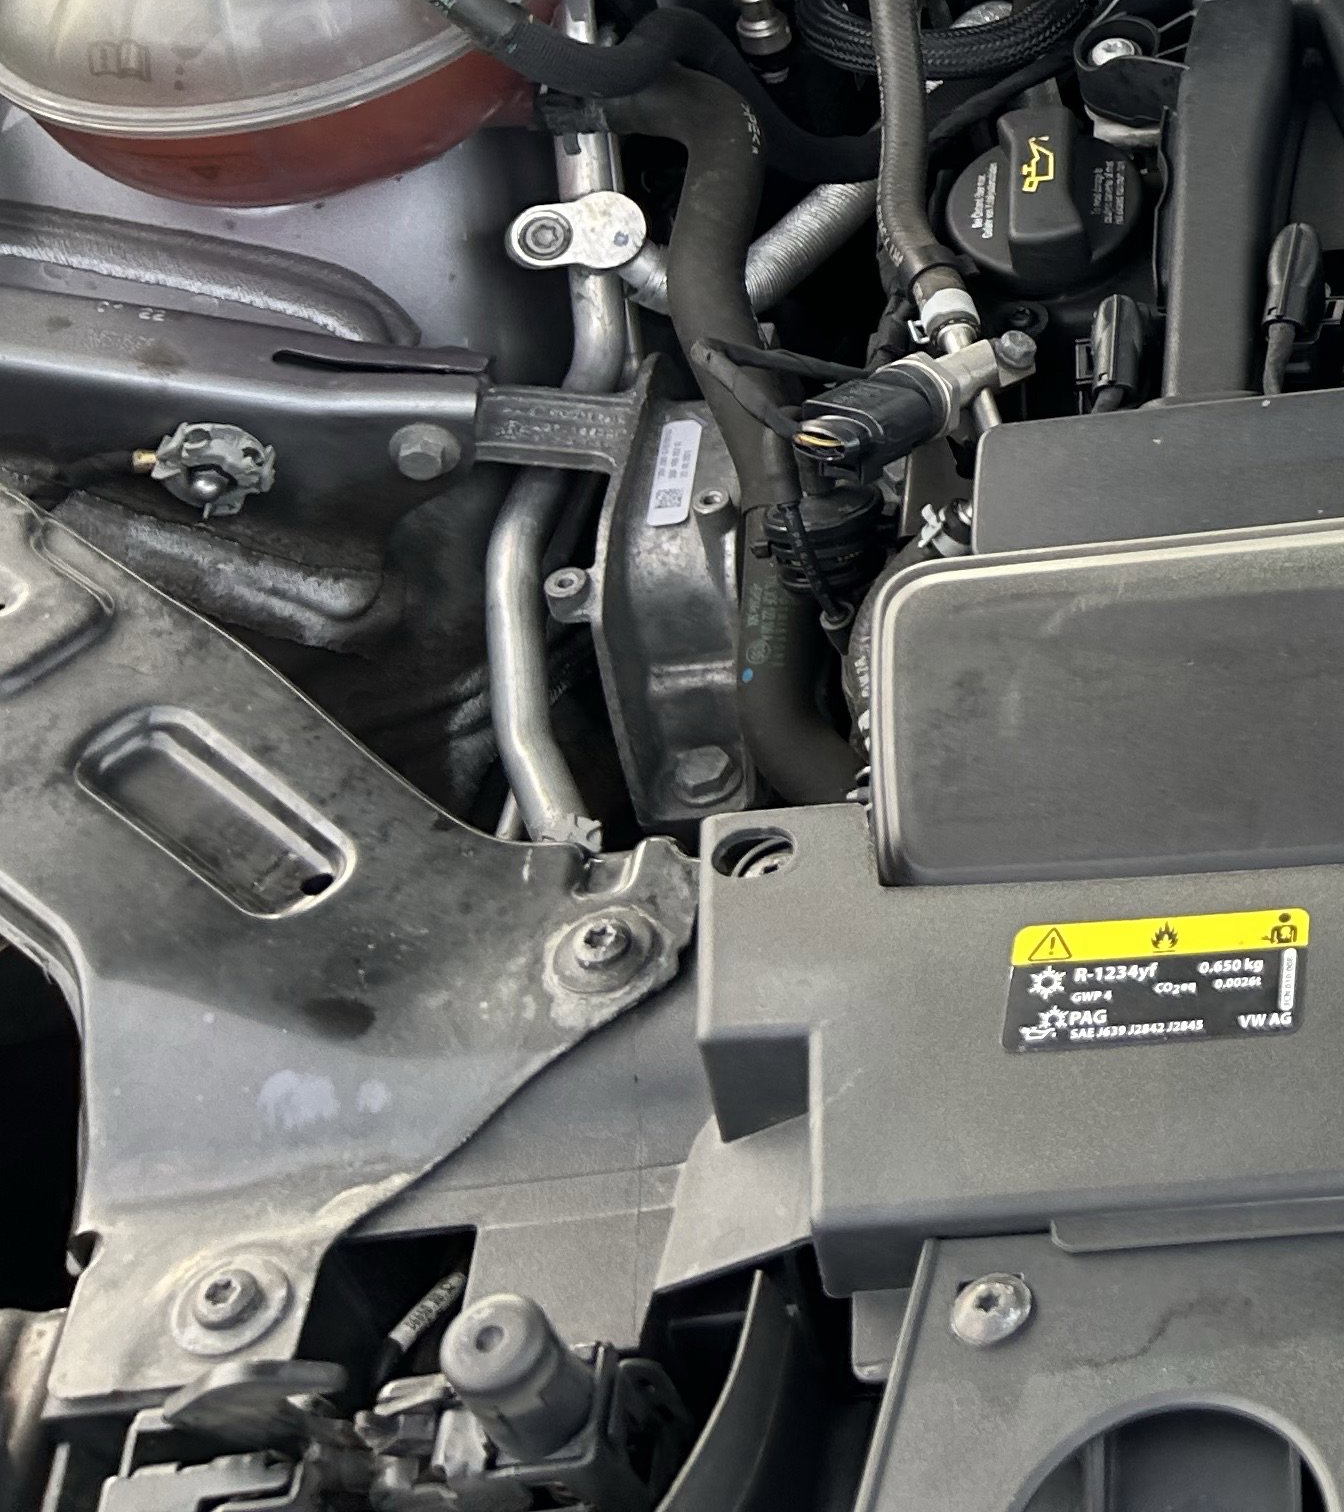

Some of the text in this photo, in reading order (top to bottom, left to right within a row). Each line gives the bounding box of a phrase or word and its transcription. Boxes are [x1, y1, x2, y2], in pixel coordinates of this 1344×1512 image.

[1073, 963, 1157, 983] R-1234yf
[1198, 957, 1263, 973] 0.650 kg
[1070, 989, 1112, 1002] GWP 4
[1068, 1009, 1106, 1025] PAG
[1238, 1012, 1291, 1028] VW AG
[1069, 1019, 1203, 1038] SAE J639 J2842 J2845
